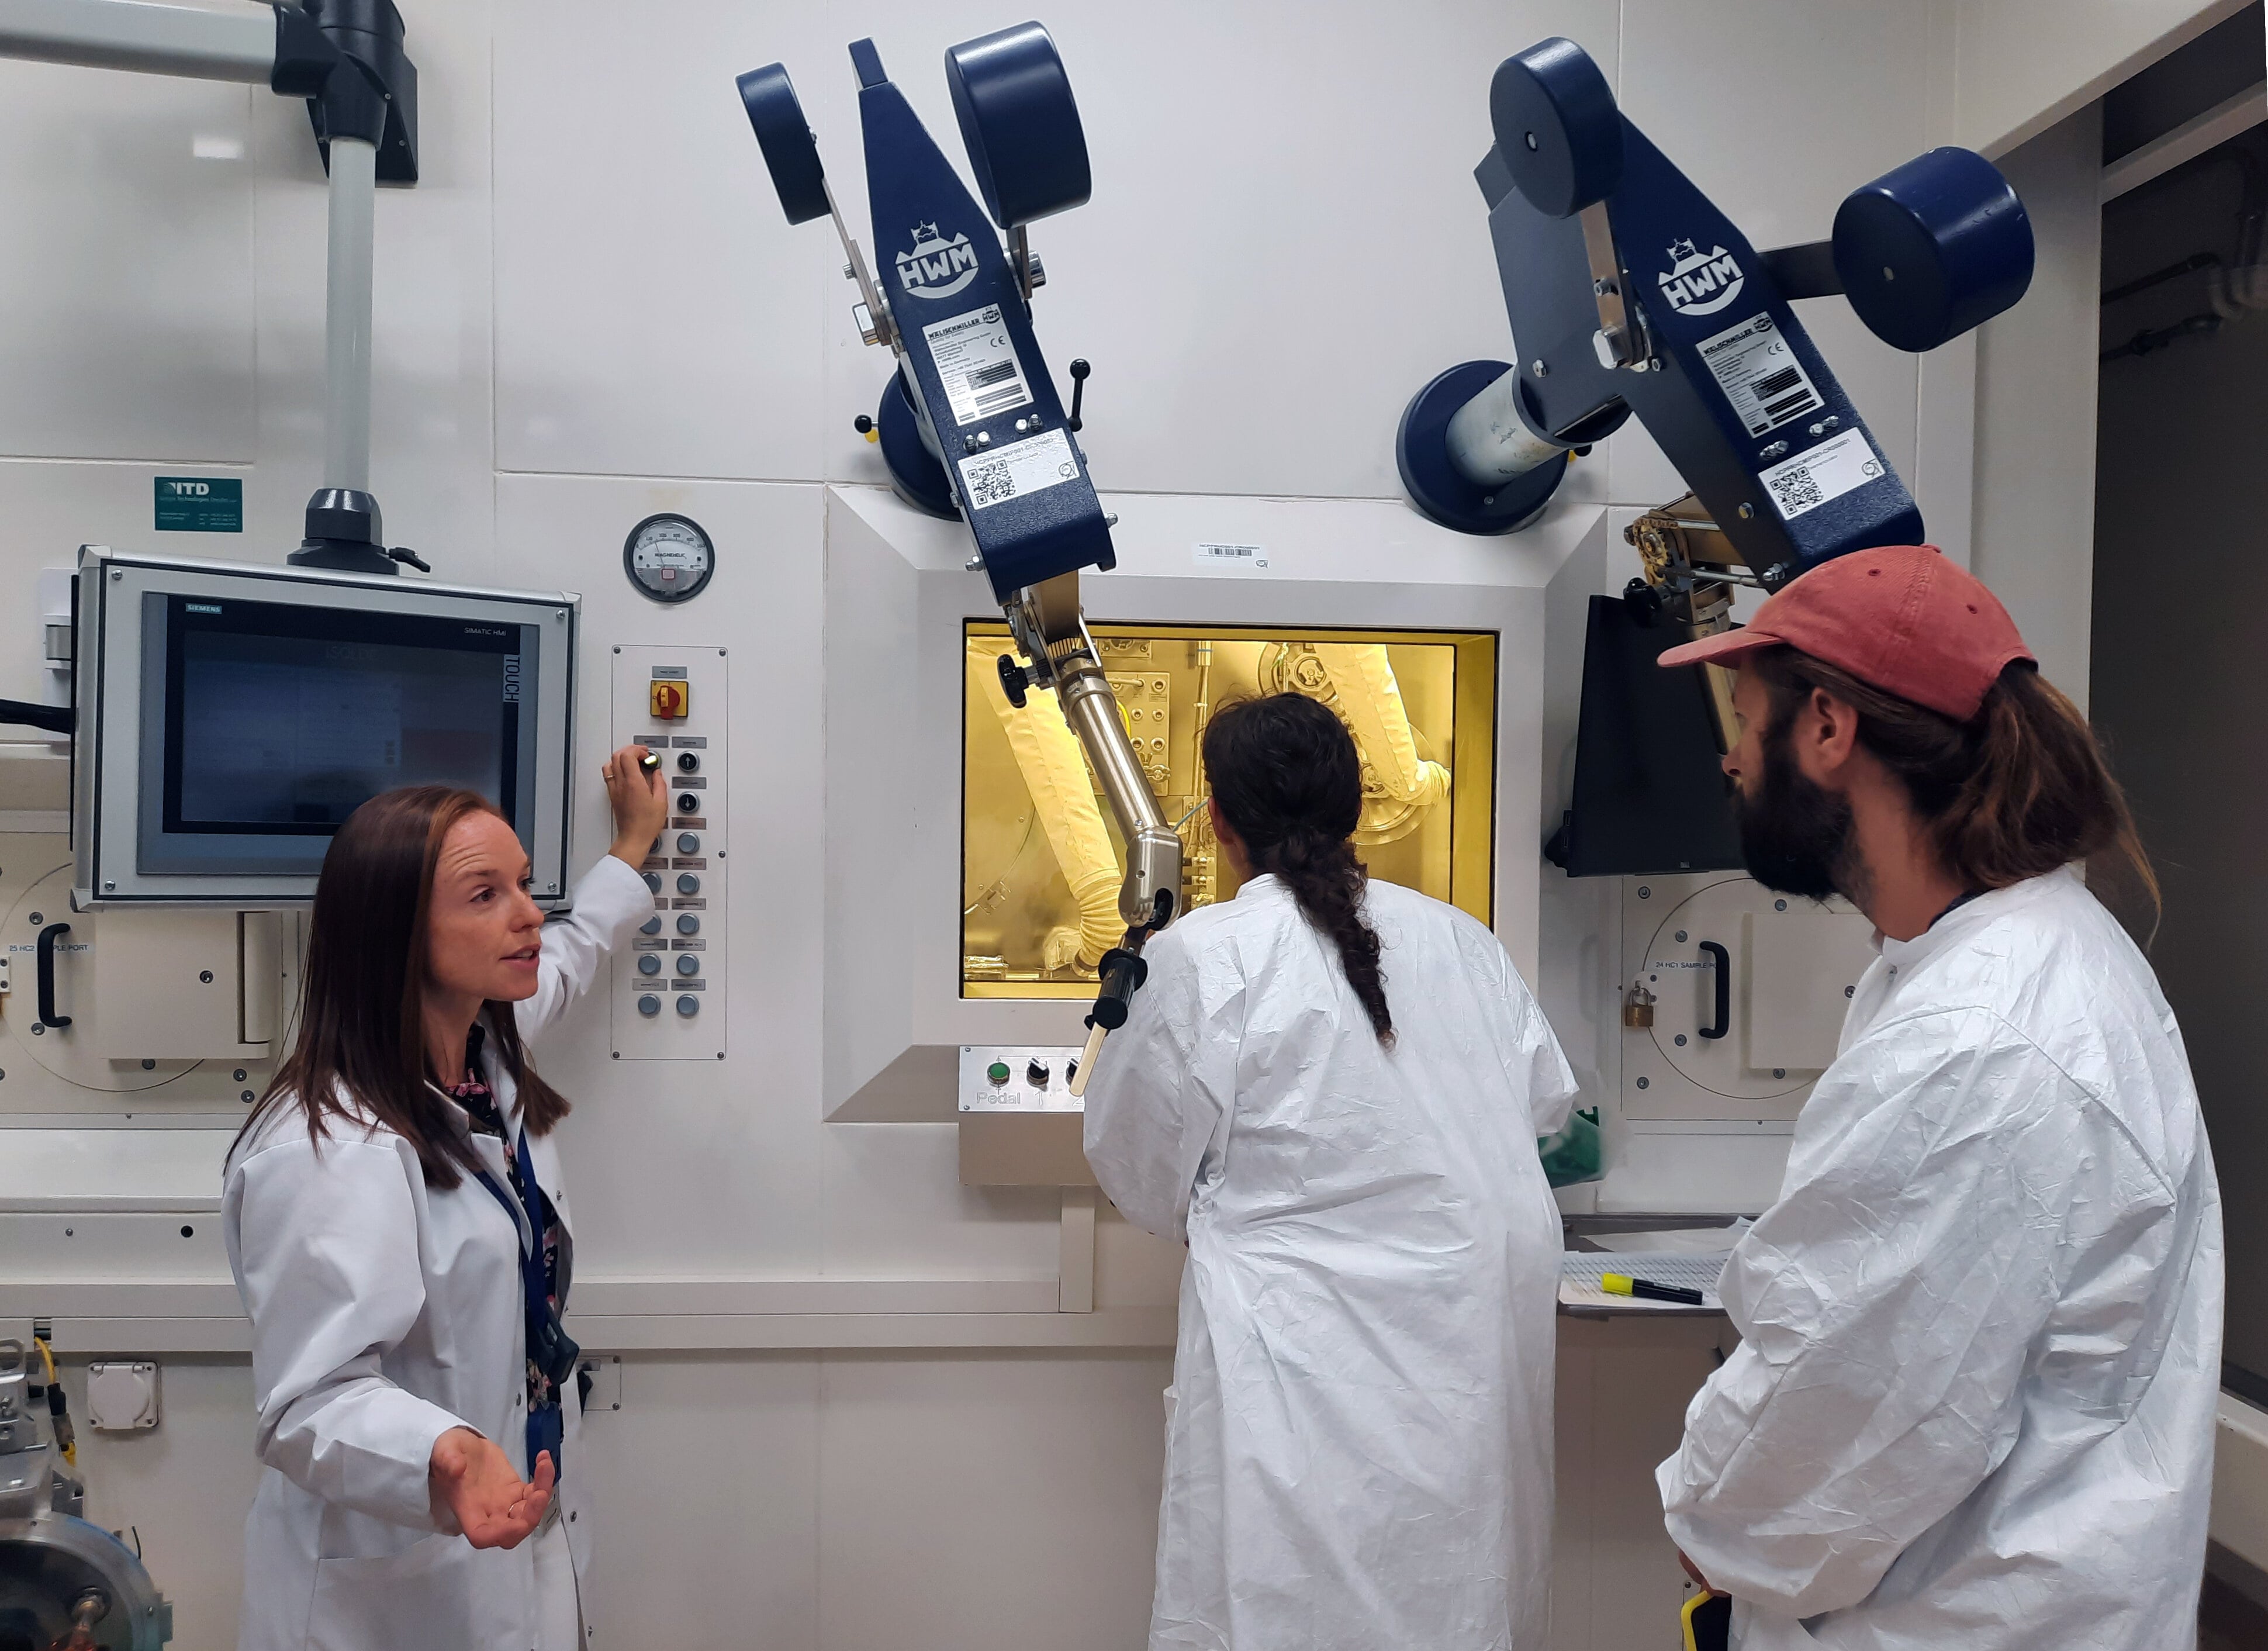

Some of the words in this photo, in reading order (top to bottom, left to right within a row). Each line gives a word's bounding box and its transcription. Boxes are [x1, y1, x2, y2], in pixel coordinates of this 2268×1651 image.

[897, 243, 979, 289] HWM
[1661, 254, 1743, 309] HWM
[177, 482, 209, 496] ITD
[186, 604, 222, 613] SIEMENS
[505, 656, 520, 702] TOUCH
[976, 1092, 1021, 1104] Pedal
